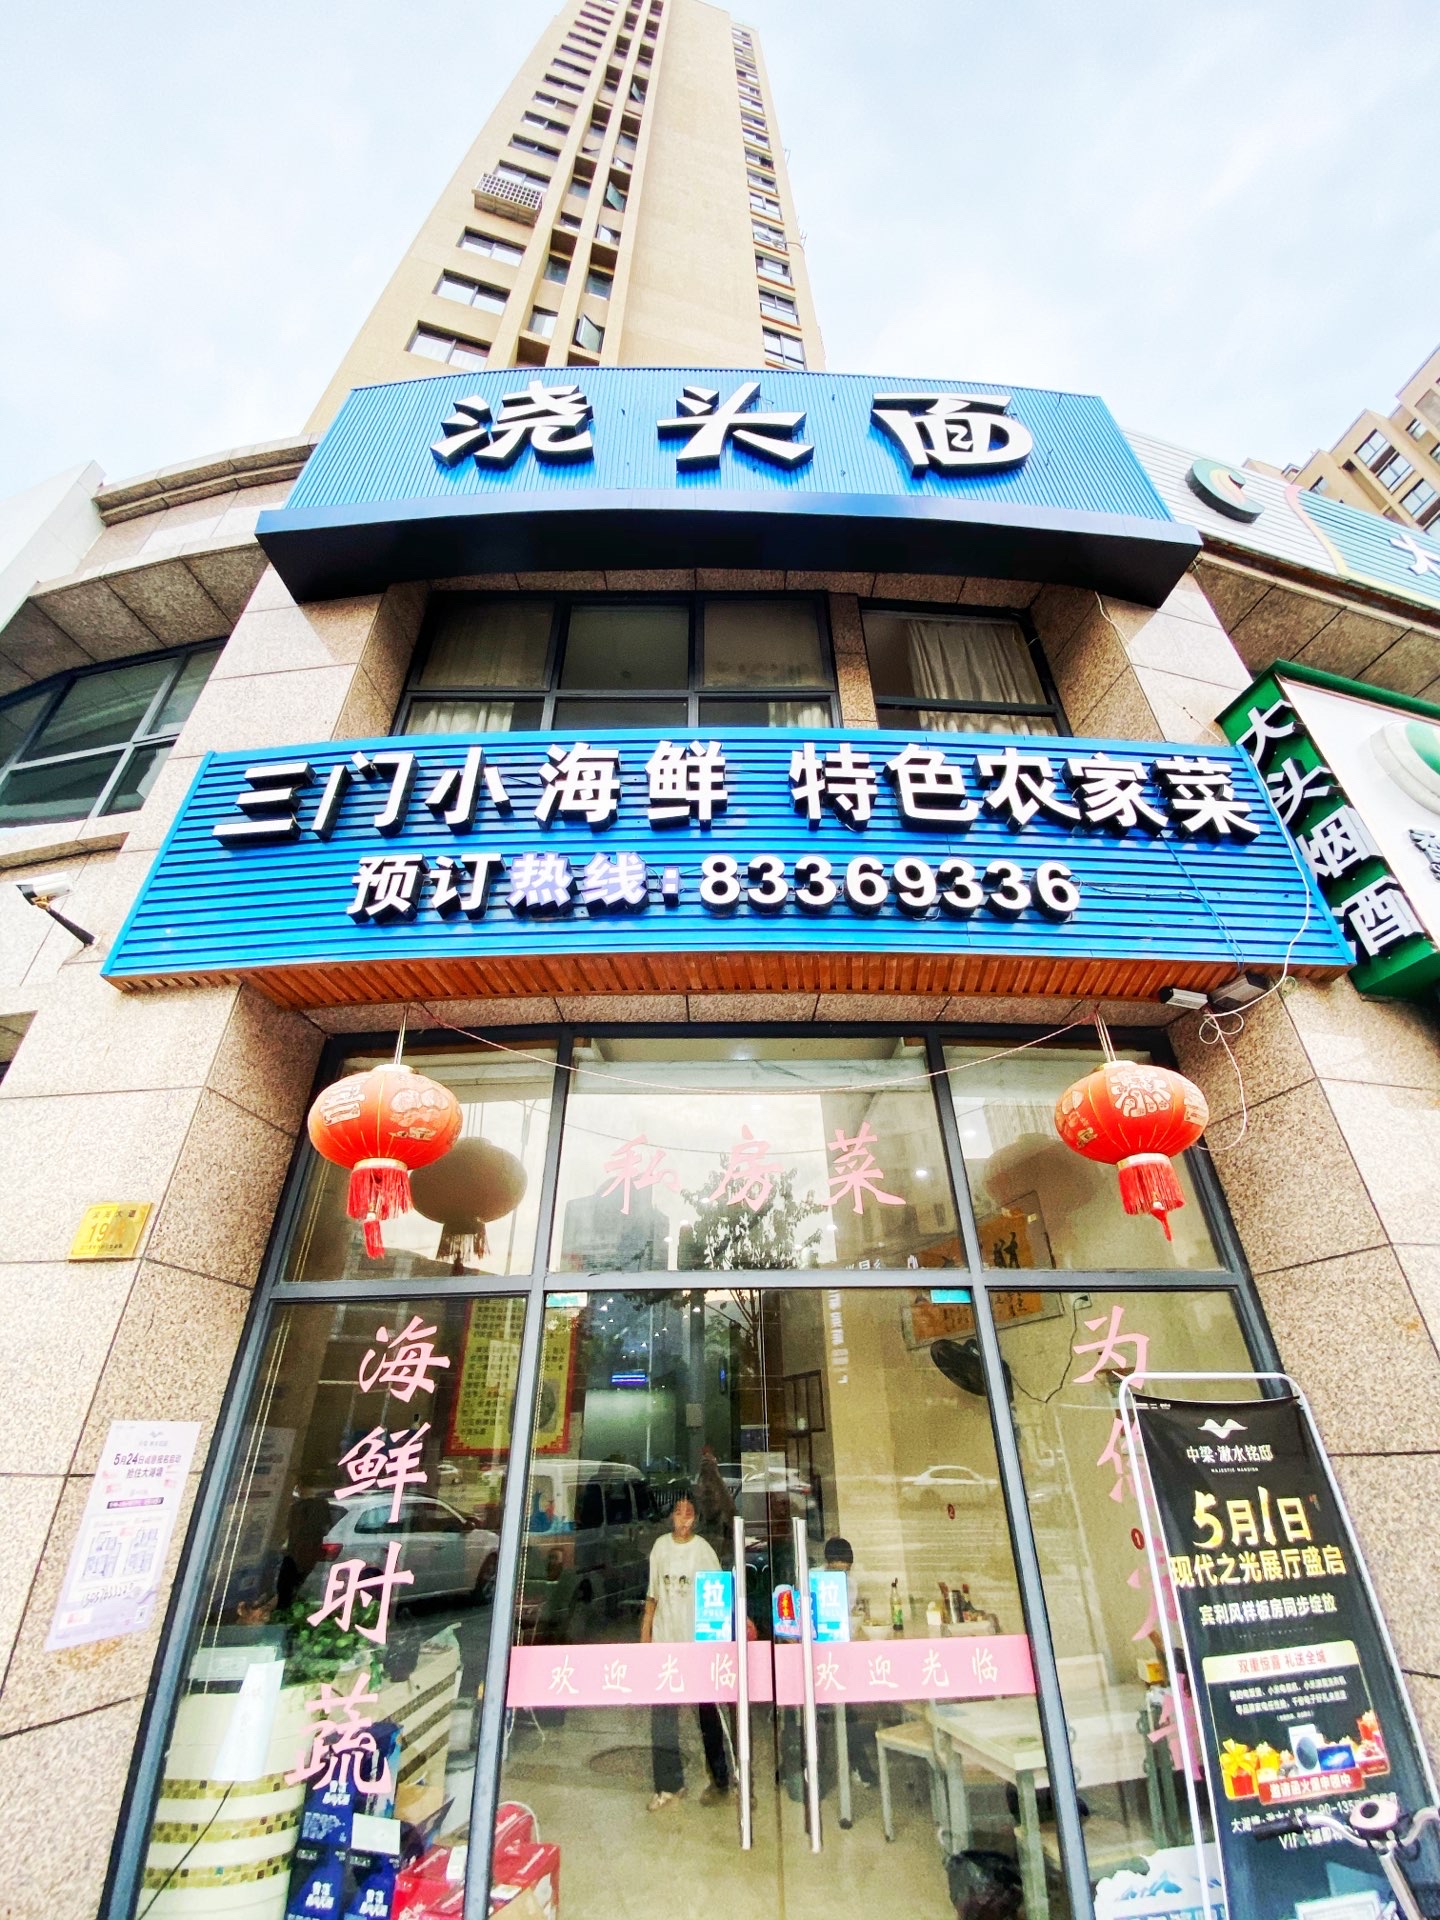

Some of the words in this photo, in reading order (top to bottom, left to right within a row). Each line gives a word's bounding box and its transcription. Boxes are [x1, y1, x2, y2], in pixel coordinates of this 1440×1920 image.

[431, 379, 1033, 478] 浇头面
[211, 740, 729, 845] 三门小海鲜
[789, 741, 1261, 838] 特色农家菜
[600, 1120, 906, 1216] 私房菜
[1192, 1485, 1313, 1549] 5月1日
[284, 1315, 451, 1796] 海鲜时蔬
[1169, 1544, 1347, 1590] 现代之光展厅盛启
[702, 1579, 725, 1608] 拉
[818, 1580, 842, 1608] 拉
[549, 1652, 738, 1696] 欢迎光临
[815, 1647, 999, 1694] 欢迎光临
